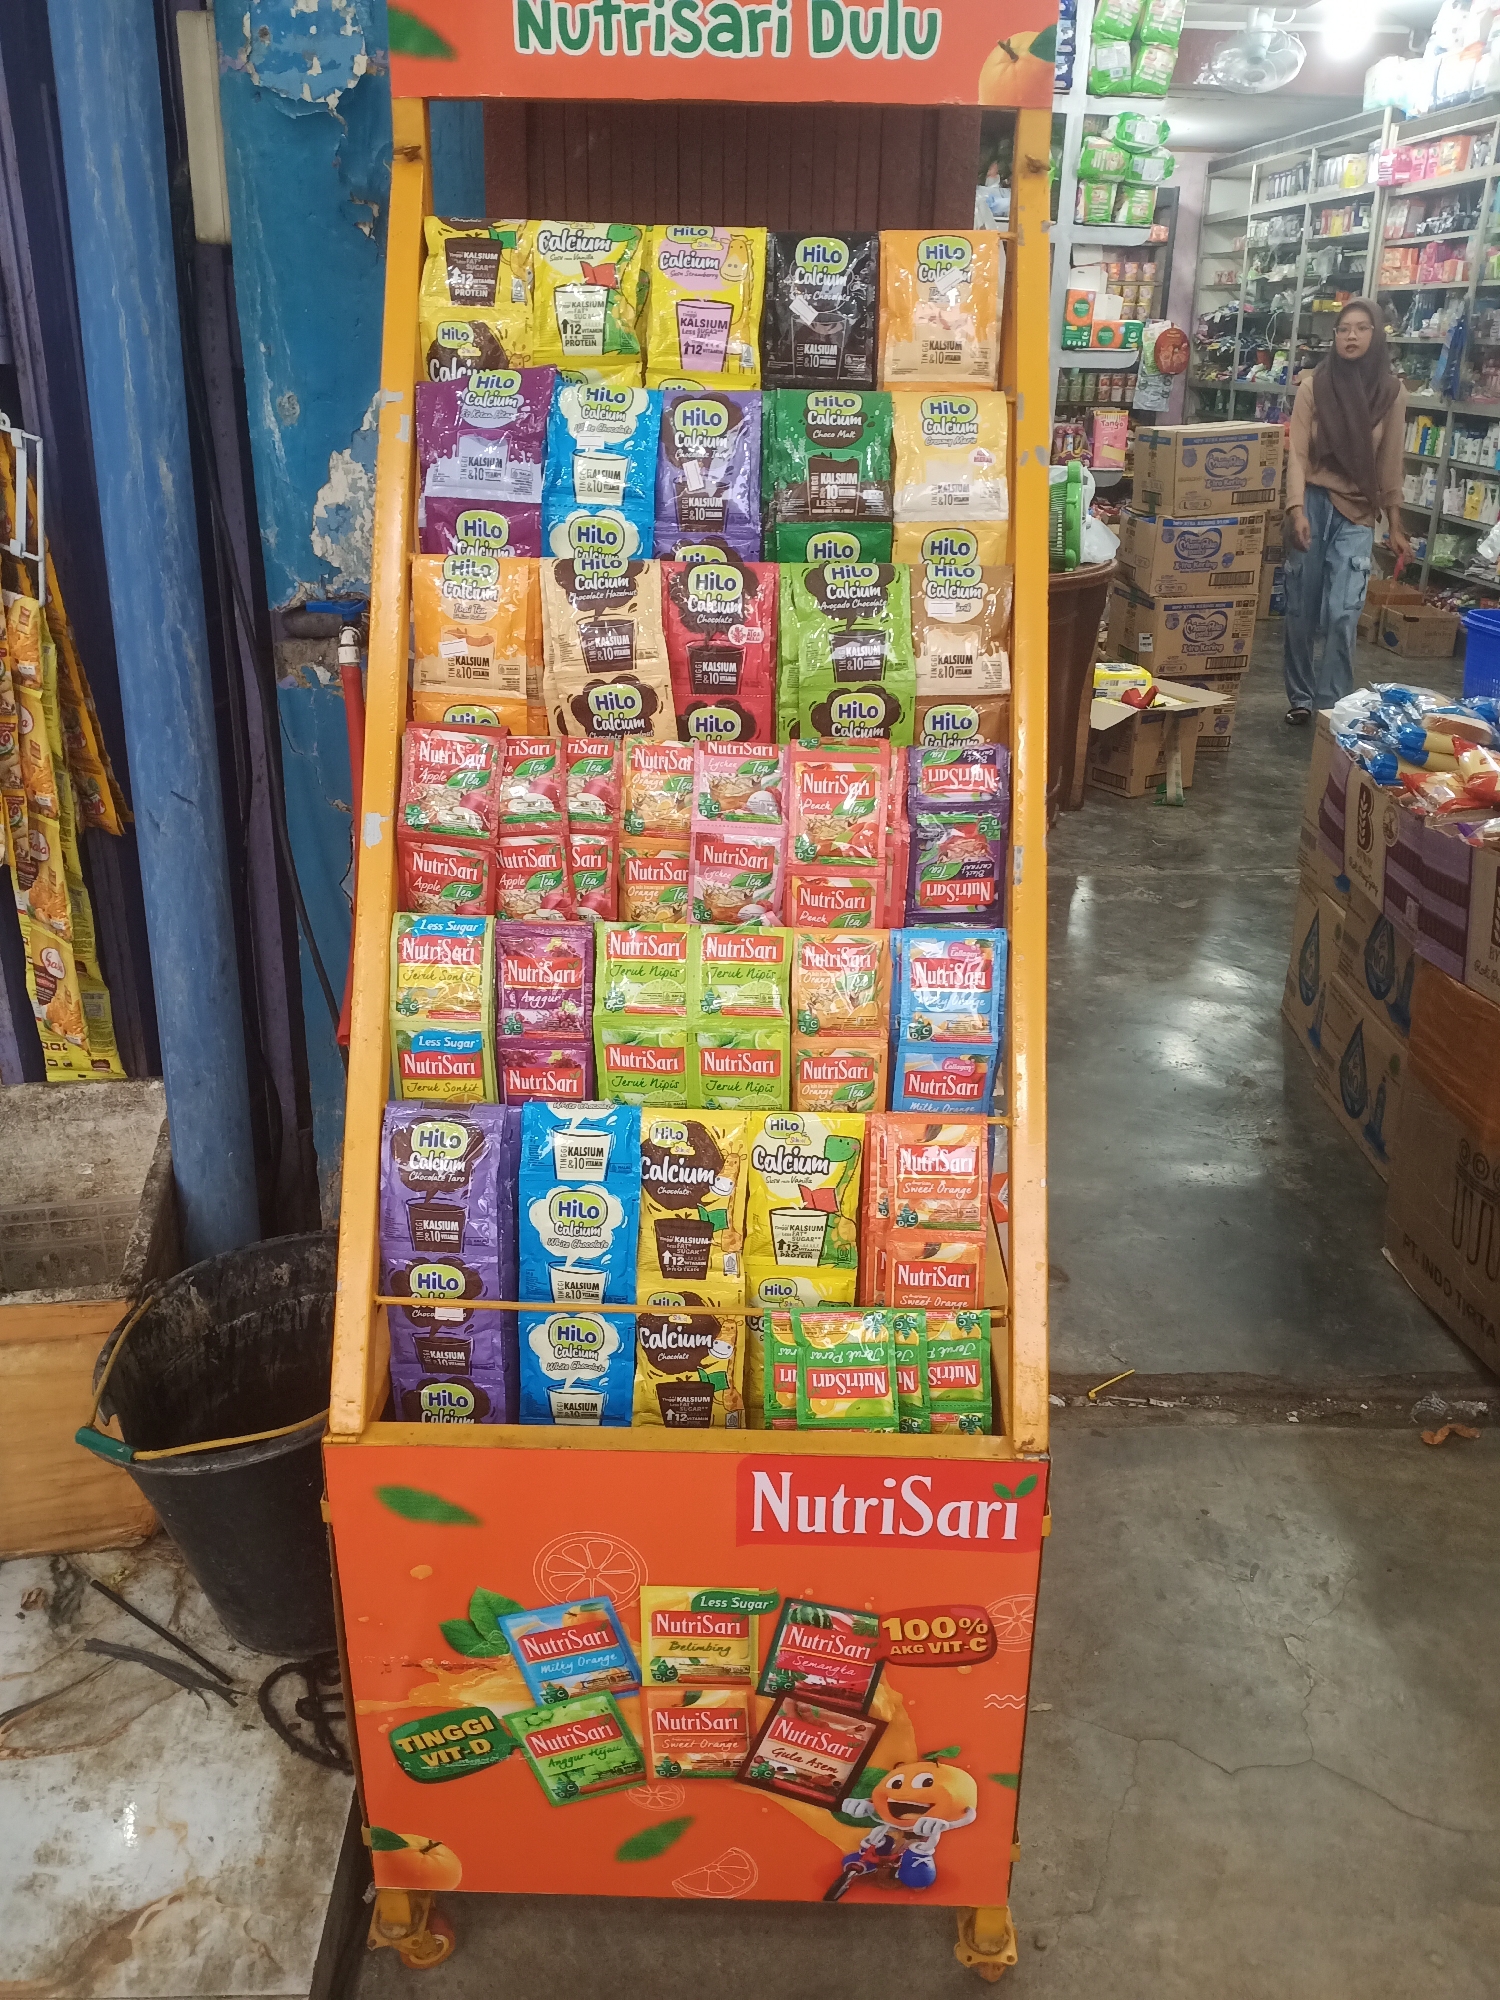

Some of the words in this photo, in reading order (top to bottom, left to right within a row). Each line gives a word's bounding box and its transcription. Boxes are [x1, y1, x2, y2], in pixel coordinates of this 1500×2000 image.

[514, 0, 793, 57] NutriSari
[811, 2, 941, 59] Dulu
[673, 226, 709, 237] HiLo
[538, 229, 613, 254] Calcium
[463, 251, 499, 261] KALSIUM
[659, 250, 720, 271] Calcium
[803, 244, 843, 264] HiLo
[925, 244, 967, 261] HiLo
[794, 265, 848, 287] Calcium
[454, 288, 488, 298] PROTEIN
[680, 317, 728, 330] KALSIUM
[440, 328, 470, 342] HiLo
[565, 339, 597, 347] PROTEIN
[804, 344, 838, 355] KALSIUM
[475, 375, 515, 390] HiLo
[463, 391, 518, 408] Calcium
[586, 387, 626, 404] HiLo
[814, 396, 856, 407] HiLo
[581, 404, 627, 422] Calcium
[929, 401, 971, 415] HiLo
[682, 407, 722, 427] HiLo
[807, 409, 862, 426] Calcium
[923, 417, 978, 434] Calcium
[1100, 420, 1124, 429] Tango
[812, 430, 836, 439] Choco
[837, 429, 856, 439] Malt
[820, 473, 858, 485] KALSIUM
[464, 518, 503, 538] HiLo
[577, 525, 618, 546] HiLo
[813, 539, 854, 559] HiLo
[929, 538, 971, 557] HiLo
[581, 558, 623, 571] HiLo
[933, 565, 976, 578] HiLo
[695, 571, 736, 592] HiLo
[831, 567, 873, 580] HiLo
[442, 578, 499, 601] Calcium
[574, 576, 631, 591] Calcium
[826, 581, 882, 599] Calcium
[927, 582, 983, 600] Calcium
[687, 594, 743, 615] Calcium
[455, 656, 490, 668] KALSIUM
[702, 661, 737, 673] KALSIUM
[594, 691, 636, 711] HiLo
[838, 702, 879, 719] HiLo
[593, 716, 645, 731] Calcium
[695, 715, 735, 733] HiLo
[831, 722, 885, 738] Calcium
[931, 713, 972, 731] HiLo
[419, 739, 486, 770] NutriSari
[707, 741, 773, 757] NutriSari
[419, 766, 447, 783] Apple
[527, 759, 547, 773] Tea
[585, 759, 604, 773] Tea
[462, 771, 481, 786] Tea
[803, 772, 870, 796] NutriSari
[927, 766, 995, 790] NutriSari
[802, 798, 831, 812] Peach
[702, 844, 768, 870] NutriSari
[412, 851, 478, 882] NutriSari
[413, 876, 442, 893] Apple
[499, 874, 526, 891] Apple
[453, 884, 474, 899] Tea
[627, 886, 660, 902] Orange
[800, 887, 866, 910] NutriSari
[926, 882, 992, 903] NutriSari
[420, 919, 445, 931] Less
[799, 910, 829, 923] Peach
[403, 937, 475, 963] NutriSari
[608, 931, 681, 957] NutriSari
[706, 935, 778, 960] NutriSari
[803, 945, 872, 968] NutriSari
[507, 959, 577, 984] NutriSari
[609, 964, 645, 977] Jeruk
[648, 965, 680, 979] Nipis
[708, 966, 743, 979] Jeruk
[746, 967, 777, 980] Nipis
[914, 962, 987, 987] NutriSari
[520, 991, 560, 1008] Anggur
[418, 1036, 443, 1048] Less
[404, 1053, 476, 1075] NutriSari
[609, 1047, 679, 1071] NutriSari
[703, 1051, 775, 1074] NutriSari
[943, 1062, 974, 1073] Collagen
[803, 1059, 869, 1080] NutriSari
[406, 1081, 440, 1093] Jeruk
[442, 1081, 480, 1093] Sonkit
[508, 1068, 578, 1093] NutriSari
[611, 1075, 647, 1089] Jeruk
[649, 1078, 680, 1091] Nipis
[706, 1079, 742, 1092] Jeruk
[744, 1081, 775, 1094] Nipis
[909, 1073, 979, 1096] NutriSari
[846, 1083, 867, 1099] Tea
[770, 1118, 801, 1134] HiLo
[419, 1129, 463, 1149] HiLo
[567, 1146, 604, 1158] KALSIUM
[751, 1144, 831, 1175] Calcium
[899, 1147, 974, 1174] NutriSari
[409, 1151, 467, 1173] Calcium
[640, 1156, 717, 1185] Calcium
[903, 1183, 934, 1195] Sweet
[936, 1182, 973, 1200] Orange
[558, 1200, 600, 1219] HiLo
[423, 1219, 460, 1232] KALSIUM
[553, 1221, 602, 1238] Calcium
[546, 1237, 571, 1249] White
[571, 1238, 610, 1250] Chocolate
[417, 1273, 459, 1291] HiLo
[897, 1264, 971, 1289] NutriSari
[564, 1281, 600, 1292] KALSIUM
[764, 1284, 794, 1297] HiLo
[899, 1295, 932, 1306] Sweet
[933, 1297, 970, 1310] Orange
[1422, 1253, 1453, 1297] INDO
[1455, 1288, 1496, 1346] TIRTA
[557, 1325, 598, 1344] HiLo
[640, 1323, 714, 1350] Calcium
[430, 1350, 466, 1361] KALSIUM
[553, 1345, 600, 1361] Calcium
[810, 1349, 845, 1364] Peras
[846, 1347, 885, 1363] Jeruk
[812, 1371, 887, 1394] NutriSari
[428, 1391, 469, 1408] HiLo
[563, 1401, 599, 1412] KALSIUM
[750, 1469, 1019, 1542] NutriSari
[700, 1596, 728, 1608] Less
[655, 1613, 742, 1636] NutriSari
[882, 1616, 989, 1642] 100%
[521, 1628, 611, 1660] NutriSari
[668, 1640, 732, 1656] Belimbing
[787, 1625, 871, 1660] NutriSari
[890, 1644, 925, 1655] AKG
[929, 1637, 988, 1655] VIT-C
[540, 1662, 574, 1676] Milky
[577, 1652, 618, 1668] Orange
[791, 1655, 857, 1677] Semangka
[655, 1711, 739, 1731] NutriSari
[396, 1715, 496, 1755] TINGGI
[529, 1722, 615, 1755] NutriSari
[773, 1719, 854, 1759] NutriSari
[420, 1737, 493, 1768] VIT-D
[661, 1739, 697, 1750] Sweet
[699, 1739, 740, 1751] Orange
[547, 1752, 587, 1769] Anggur
[771, 1747, 804, 1763] Gula
[805, 1757, 839, 1775] Asem
